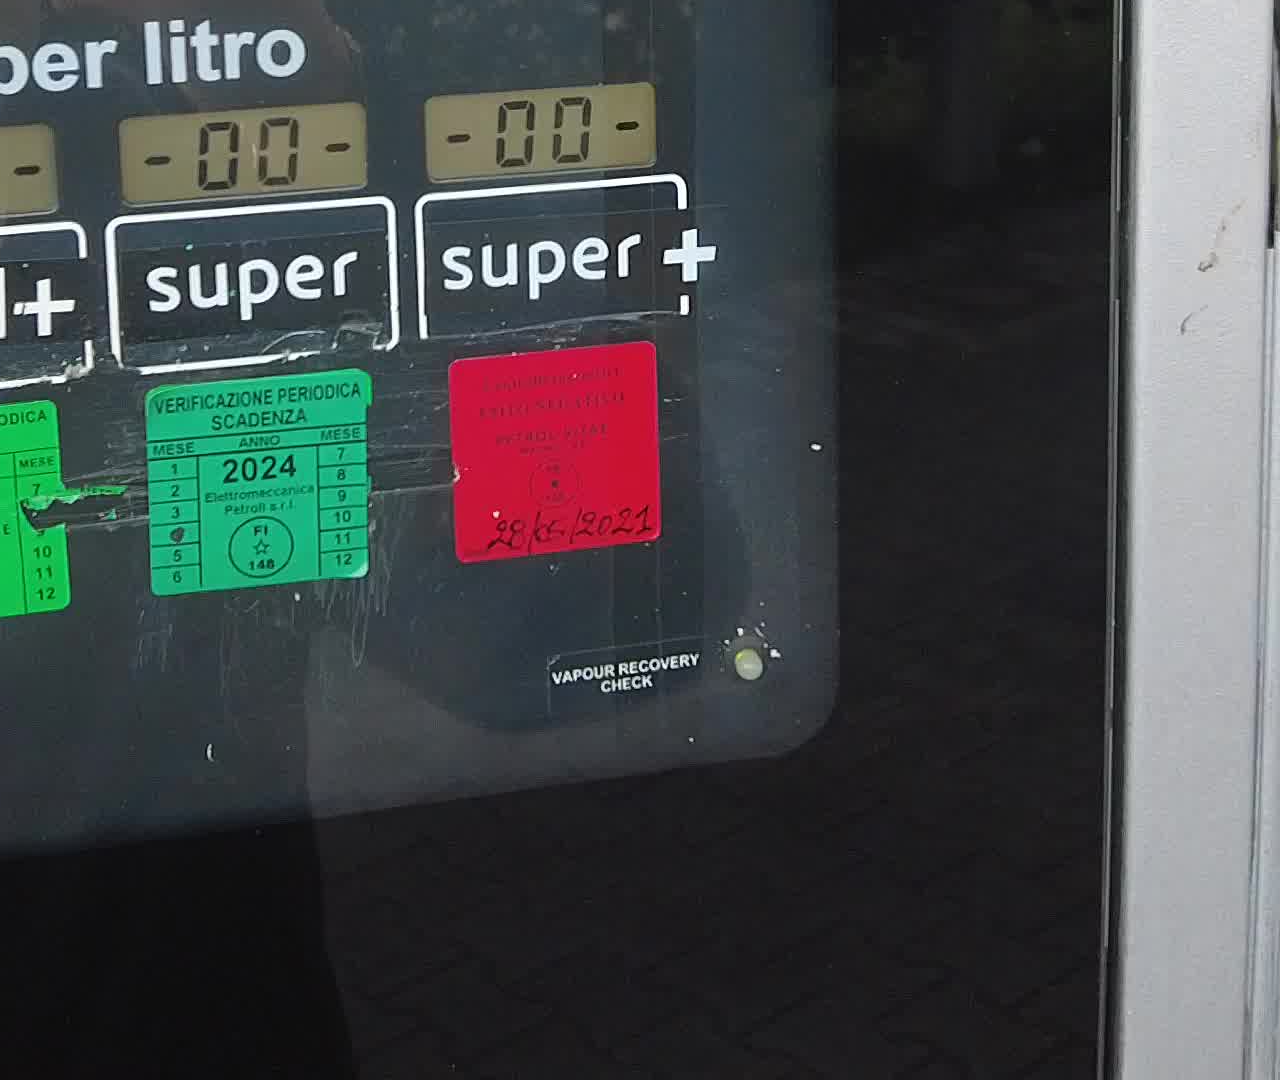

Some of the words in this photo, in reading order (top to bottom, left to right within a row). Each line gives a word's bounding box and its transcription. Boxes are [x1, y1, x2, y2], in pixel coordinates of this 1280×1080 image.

[143, 20, 306, 85] litro
[442, 233, 641, 300] super
[145, 251, 358, 321] super
[154, 389, 273, 414] VERIFICAZIONE
[278, 383, 361, 404] PERIODICA
[211, 408, 307, 431] SCADENZA
[321, 428, 361, 441] MESE
[239, 435, 280, 448] ANNO
[153, 442, 195, 456] MESE
[336, 448, 345, 459] 7
[19, 456, 55, 469] MESE
[171, 464, 178, 475] 1
[223, 455, 296, 484] 2024
[337, 469, 346, 481] 8
[32, 483, 41, 495] 7
[171, 485, 180, 497] 2
[337, 490, 346, 502] 9
[171, 506, 180, 518] 3
[334, 511, 351, 523] 10
[335, 533, 351, 545] 11
[33, 546, 52, 560] 10
[173, 550, 182, 562] 5
[335, 554, 352, 566] 12
[35, 567, 53, 580] 11
[173, 571, 182, 583] 6
[36, 587, 55, 601] 12
[552, 664, 615, 685] VAPOUR
[618, 653, 700, 676] RECOVERY
[600, 675, 653, 693] CHECK
